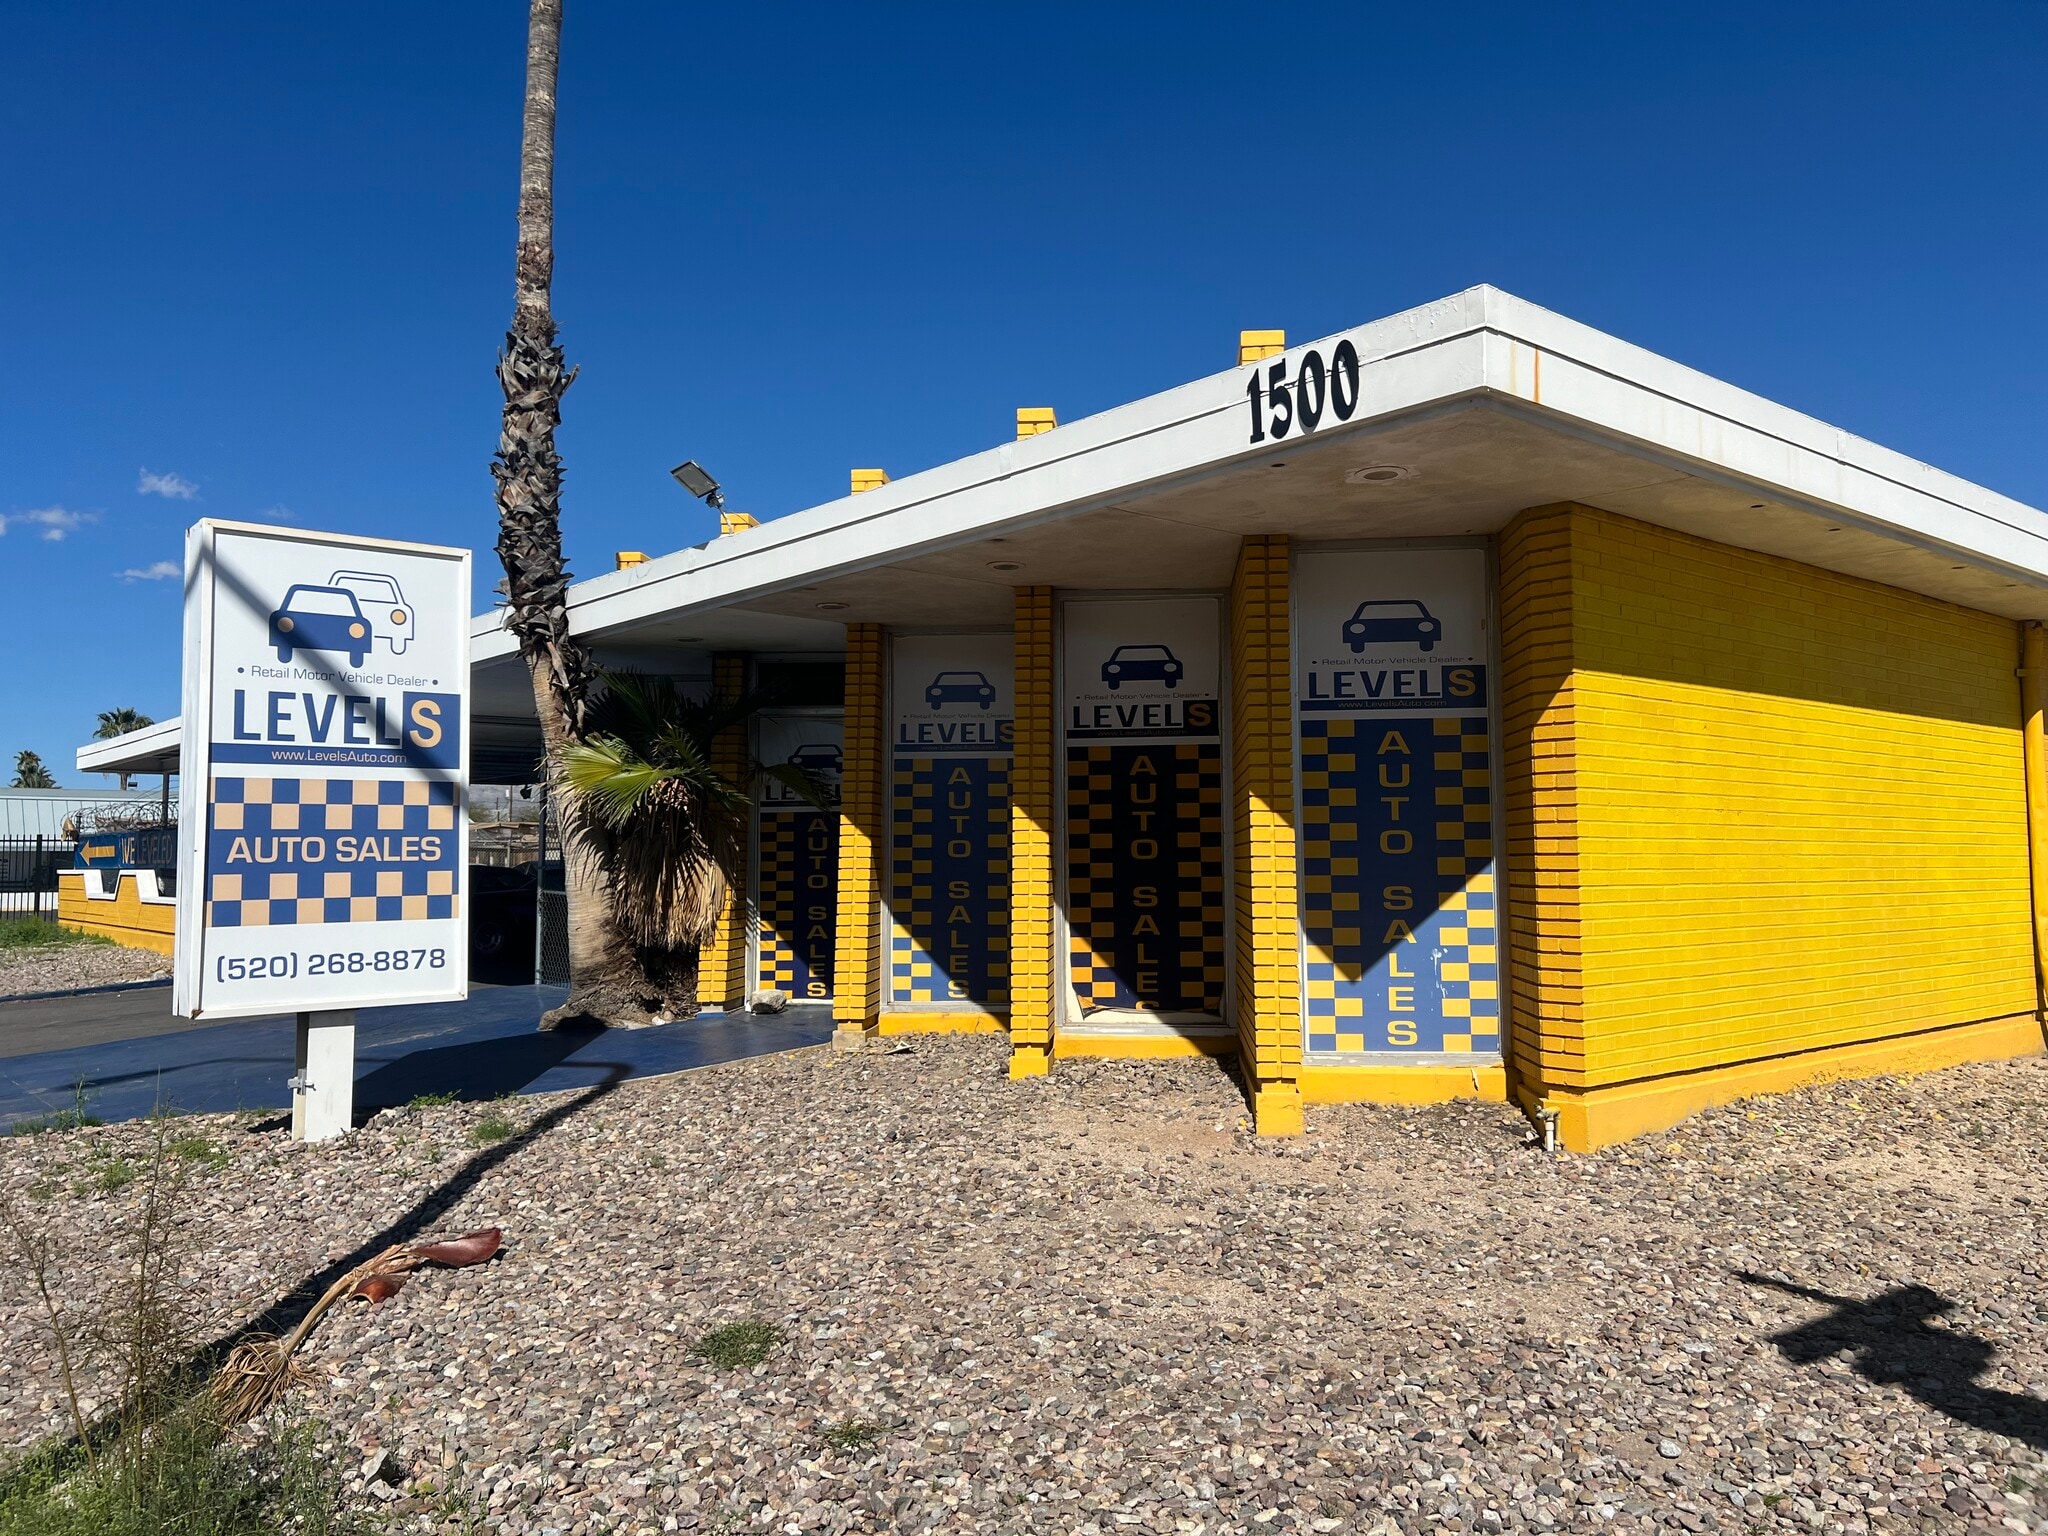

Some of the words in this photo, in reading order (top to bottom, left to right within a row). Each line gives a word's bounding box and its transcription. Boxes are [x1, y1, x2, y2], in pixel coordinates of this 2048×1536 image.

[1246, 339, 1360, 444] 1500
[251, 665, 290, 679] Retail
[294, 668, 335, 682] Motor
[338, 671, 383, 684] Vehicle
[387, 674, 429, 687] Dealer
[1321, 658, 1351, 666] Retail
[1354, 657, 1385, 665] Motor
[1389, 656, 1426, 664] Vehicle
[1429, 655, 1465, 664] Dealer
[1173, 691, 1202, 699] Dealer
[1308, 668, 1477, 699] LEVELS
[233, 689, 443, 748] LEVELS
[1073, 703, 1212, 729] LEVELS
[1337, 700, 1448, 709] www.LevelsAuto.com
[900, 722, 1015, 744] LEVELS
[271, 749, 407, 764] www.LevelsAuto.com
[1128, 755, 1159, 860] AUTO
[1376, 730, 1414, 854] AUTO
[947, 766, 972, 858] AUTO
[121, 836, 136, 865] WE
[226, 836, 326, 864] AUTO
[335, 836, 442, 862] SALES
[806, 818, 829, 889] AUTO
[806, 905, 829, 998] SALES
[947, 880, 972, 999] SALES
[216, 951, 298, 983] (520)
[308, 948, 446, 976] 268-8878
[1382, 885, 1419, 1047] SALES
